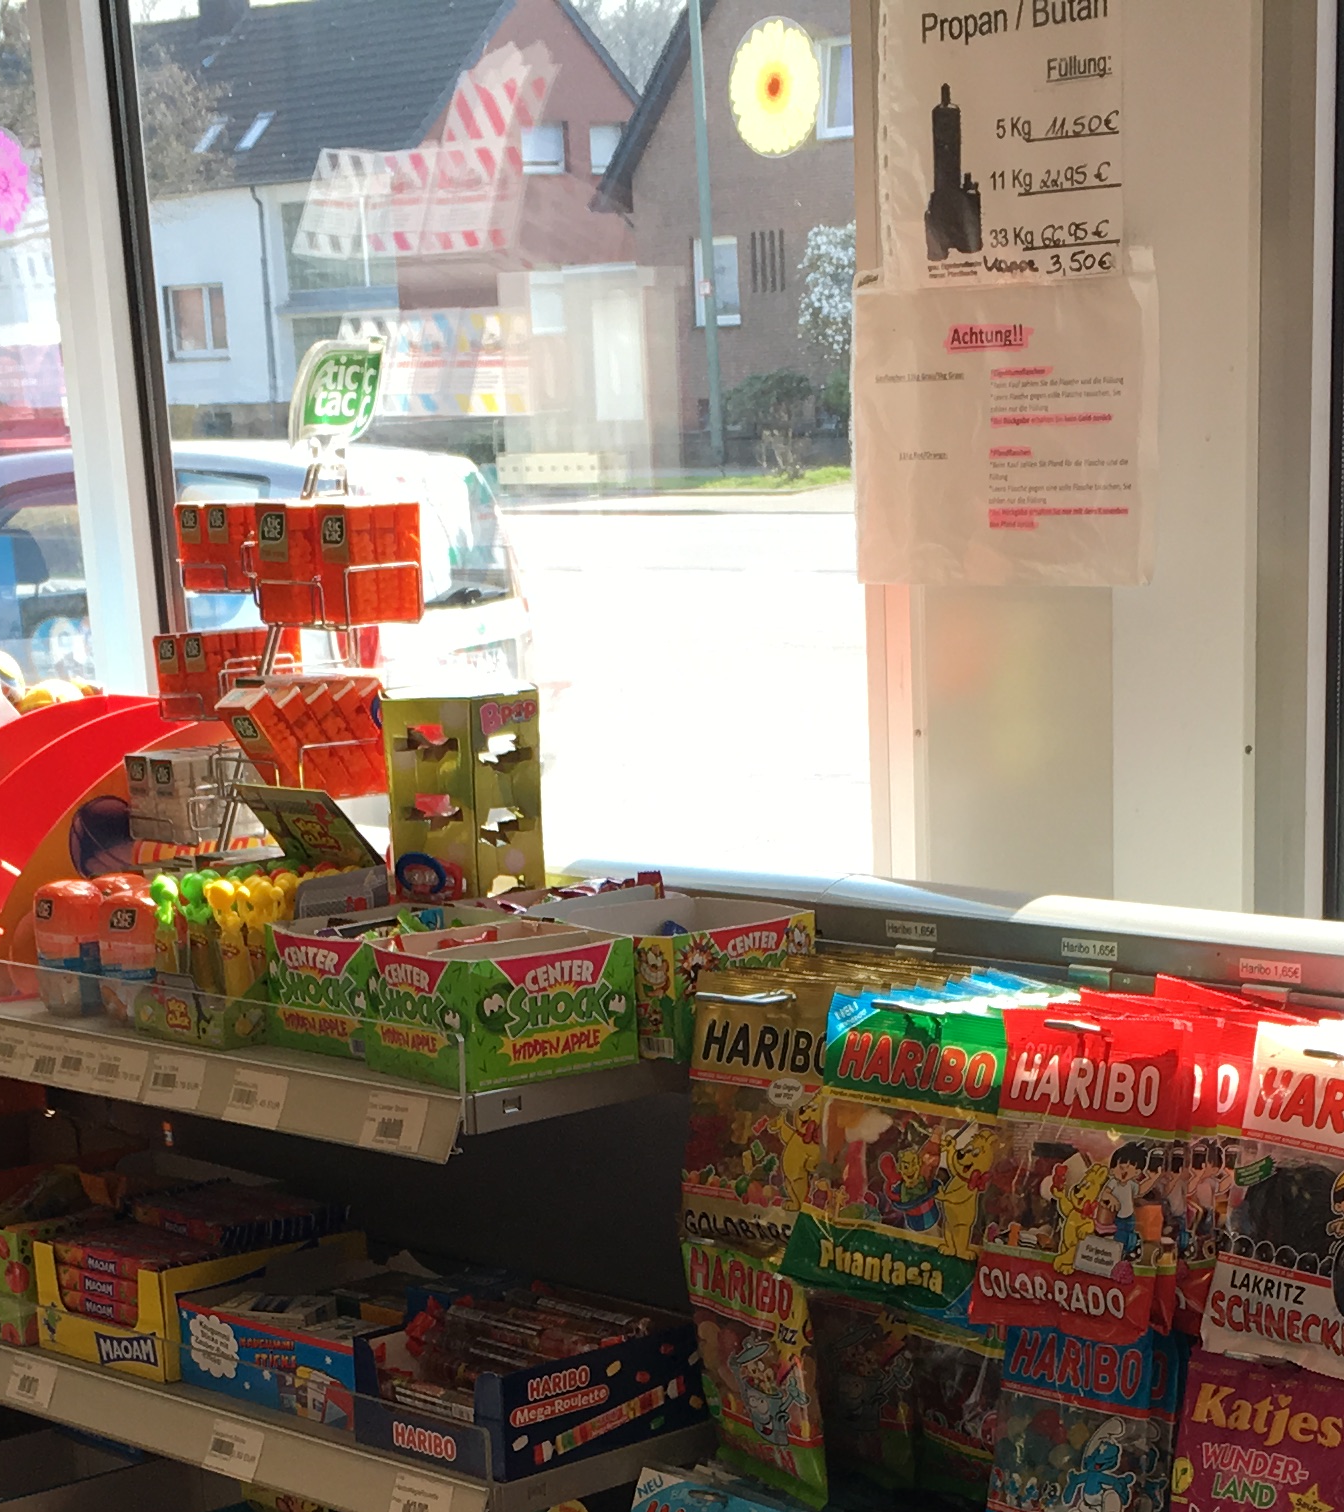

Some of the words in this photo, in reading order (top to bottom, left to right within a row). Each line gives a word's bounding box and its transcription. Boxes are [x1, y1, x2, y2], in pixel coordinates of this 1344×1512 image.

[922, 5, 1007, 45] Propan
[1032, 0, 1108, 27] Butan
[1046, 54, 1113, 83] Füllung:
[1010, 115, 1032, 143] Kg
[990, 172, 1006, 191] 11
[1011, 169, 1033, 194] Kg
[989, 228, 1009, 248] 33
[1013, 226, 1034, 251] Kg
[950, 323, 1024, 351] Achtung!!
[284, 946, 339, 973] CENTER
[728, 931, 778, 957] CENTER
[1062, 940, 1089, 954] Haribo
[1091, 945, 1116, 959] 1,65€
[279, 966, 355, 1006] SHOCK
[385, 962, 430, 990] CENTER
[525, 960, 594, 993] CENTER
[1241, 962, 1271, 977] Haribo
[1273, 966, 1301, 981] 1,65€
[379, 985, 444, 1025] SHOCK
[505, 981, 613, 1039] SHOCK
[283, 1011, 316, 1032] HIDDEN
[317, 1018, 348, 1037] APPLE
[511, 1037, 559, 1062] HIDDEN
[561, 1028, 601, 1055] APPLE
[838, 1031, 997, 1100] HARIBO
[1011, 1052, 1160, 1119] HARIBO
[87, 1254, 116, 1273] MAOAM
[819, 1239, 944, 1295] Phantasia
[84, 1277, 113, 1295] MAOAM
[1231, 1270, 1307, 1305] LAKRITZ
[100, 1332, 155, 1366] MAOAM
[1010, 1329, 1142, 1400] HARIBO
[513, 1387, 609, 1426] Mega-Roulette
[1191, 1382, 1344, 1448] Katjes
[1202, 1441, 1309, 1483] WUNDER-
[637, 1478, 665, 1498] NEU
[1212, 1472, 1278, 1508] LAND
